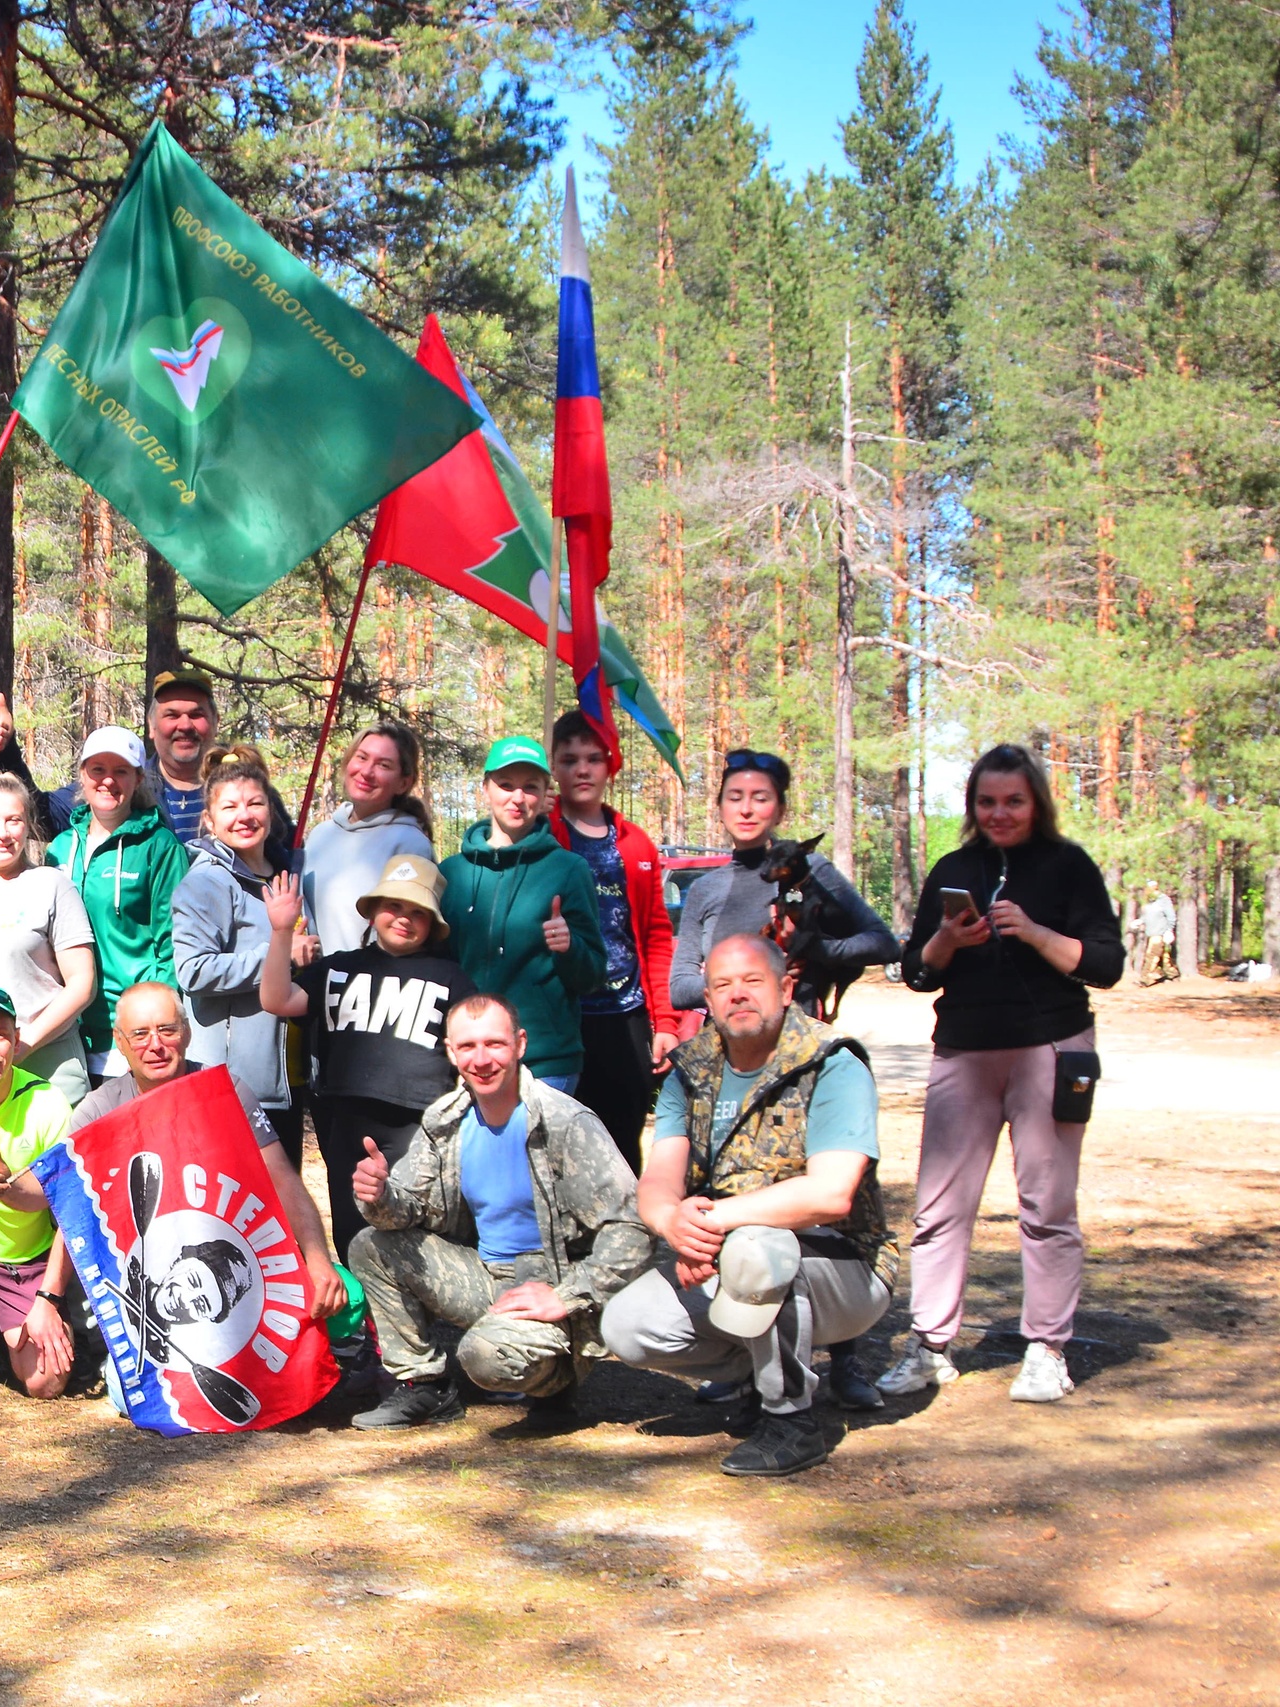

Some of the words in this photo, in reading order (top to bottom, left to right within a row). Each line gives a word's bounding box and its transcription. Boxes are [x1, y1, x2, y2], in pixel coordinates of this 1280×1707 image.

[172, 206, 257, 279] ПРОФСОЮЗ
[252, 273, 367, 379] РАБОТНИКОВ
[99, 398, 179, 474] ОТРАСЛЕЙ
[170, 479, 196, 504] РФ
[325, 968, 449, 1050] FAME
[82, 1263, 147, 1407] КОМПАНИЯ
[182, 1163, 305, 1374] СТЕПАНОВ
